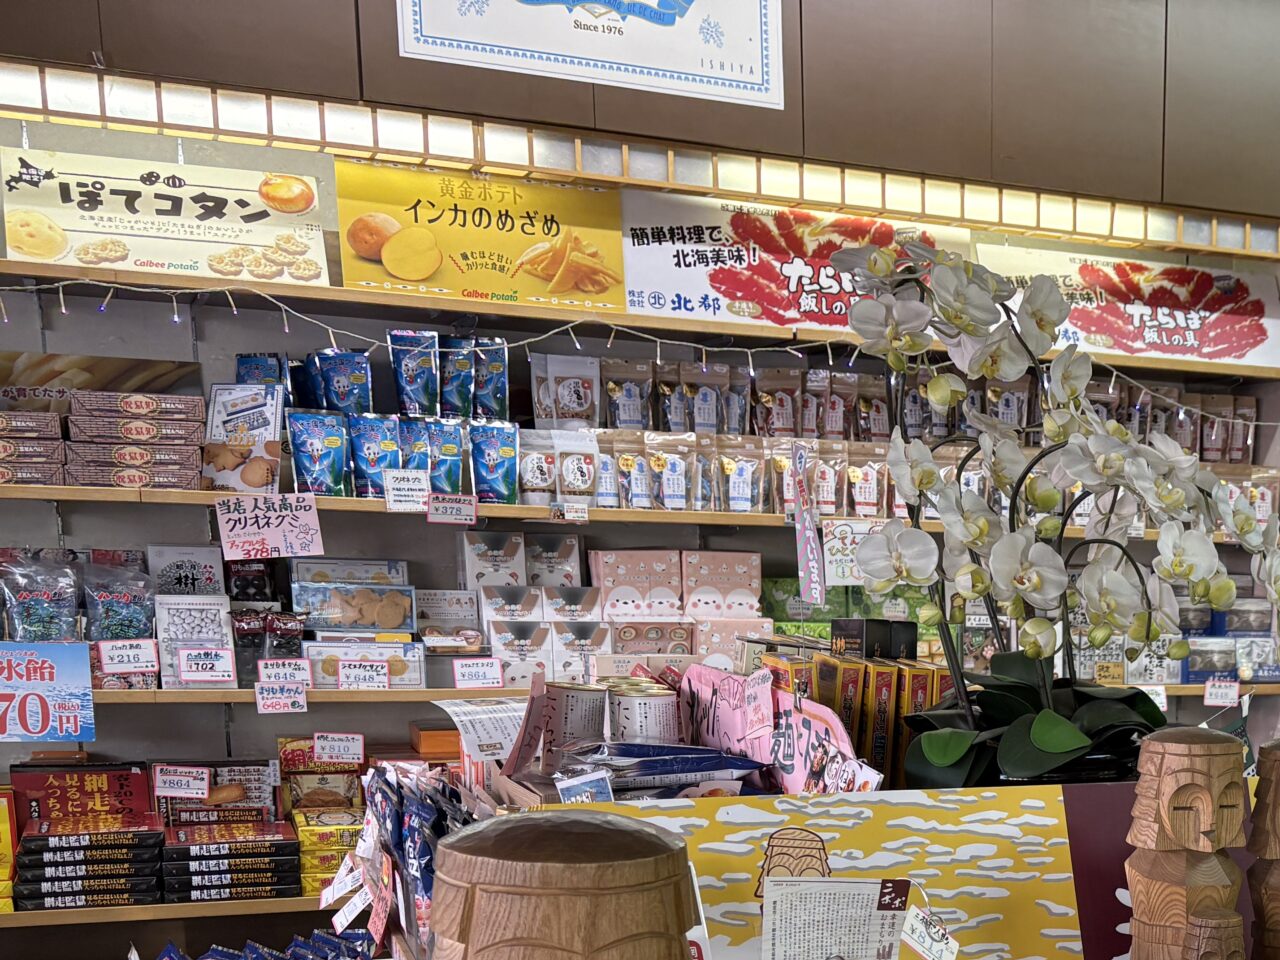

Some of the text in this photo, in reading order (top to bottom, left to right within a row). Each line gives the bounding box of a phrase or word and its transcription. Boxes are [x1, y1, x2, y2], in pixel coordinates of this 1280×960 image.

[573, 19, 624, 36] Since 1976
[700, 58, 755, 76] ISHIYA
[438, 177, 523, 205] 黄金ポテト
[58, 181, 272, 224] ぽてコタン
[404, 198, 561, 237] インカのめざめ
[630, 225, 733, 247] 簡単料理で、
[133, 258, 165, 269] Calbee
[460, 252, 513, 265] 噛むほど甘い
[461, 288, 490, 300] Calbee
[628, 289, 645, 299] 株式
[628, 298, 645, 308] 会社
[671, 293, 721, 316] 北都
[1124, 300, 1211, 329] たらば
[1142, 327, 1200, 349] 飯しの具
[218, 497, 312, 516] 当店 人気商品
[224, 513, 299, 532] クリオネグミ
[226, 539, 269, 549] アップル味
[241, 546, 281, 559] 378円
[108, 655, 141, 664] ¥216
[265, 672, 296, 681] ¥648
[344, 673, 375, 682] ¥648
[460, 671, 487, 680] ¥864
[257, 687, 303, 697] まりも羊かん
[262, 702, 290, 711] 648円
[57, 714, 81, 735] 円
[319, 744, 350, 753] ¥810
[161, 779, 191, 788] ¥864
[879, 914, 889, 947] おまもり
[887, 914, 898, 938] 幸運の
